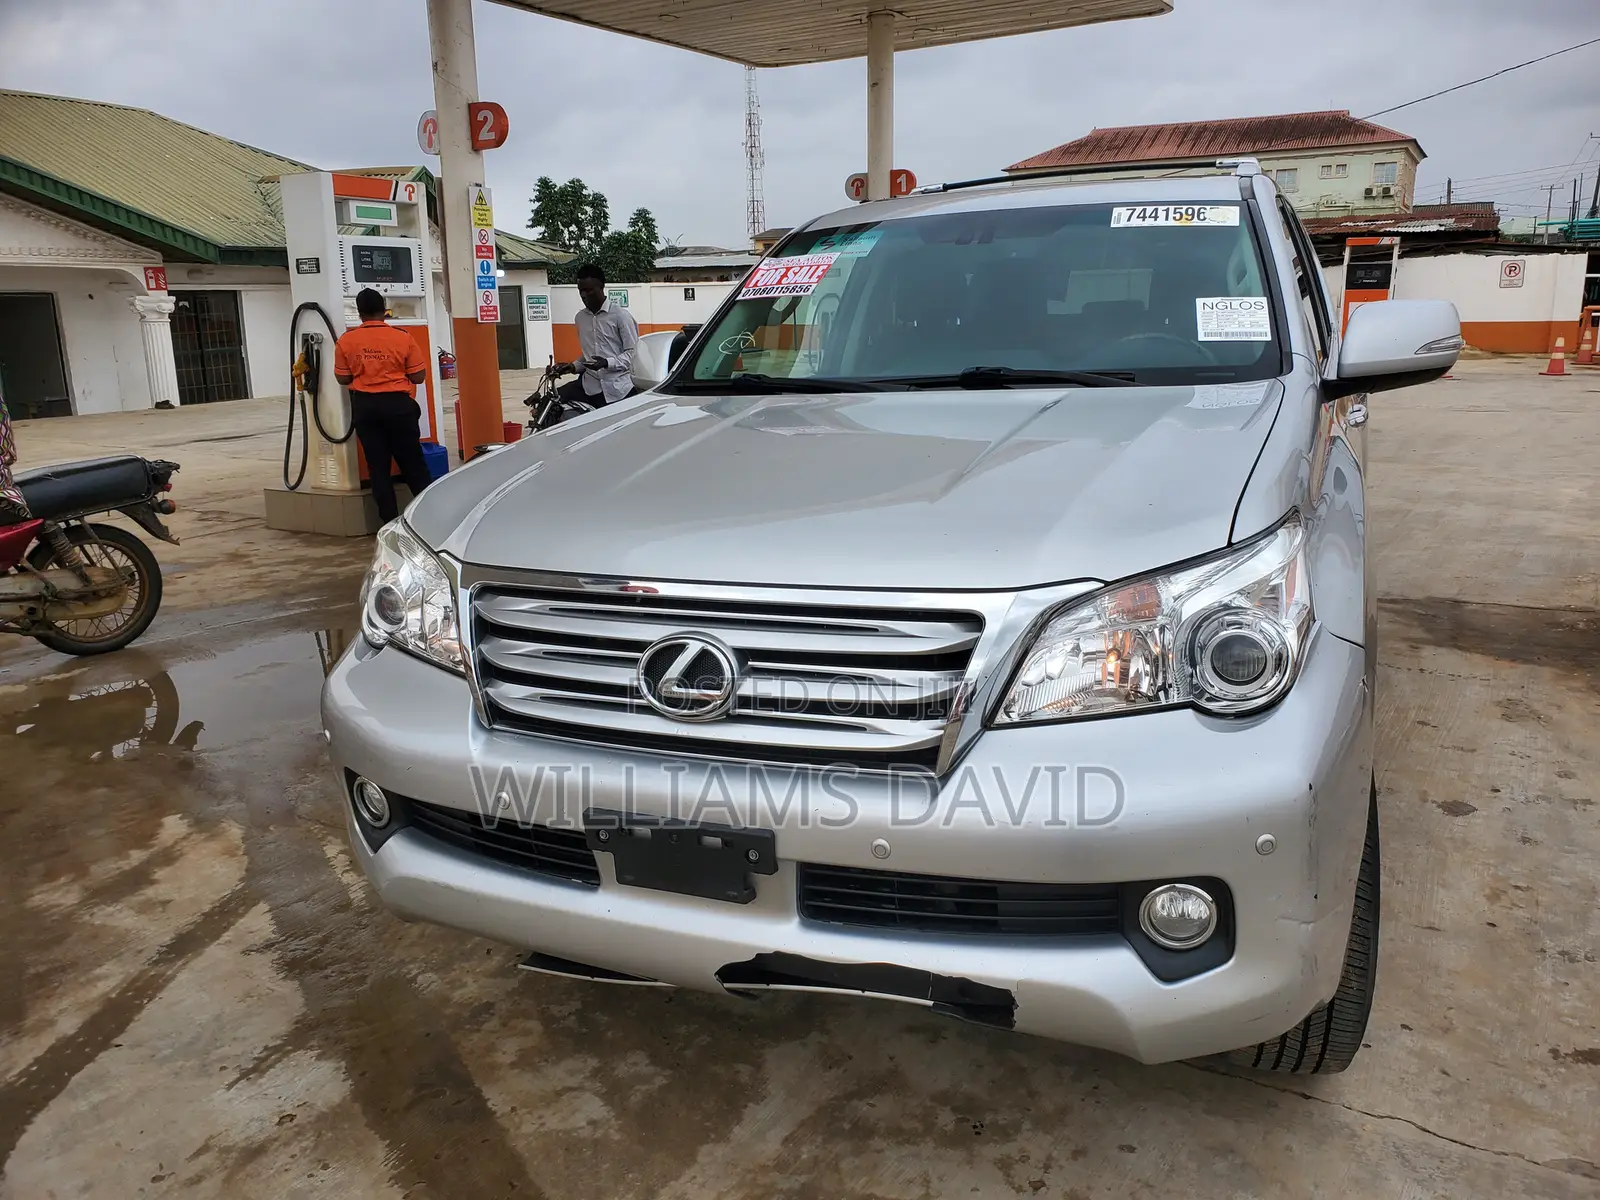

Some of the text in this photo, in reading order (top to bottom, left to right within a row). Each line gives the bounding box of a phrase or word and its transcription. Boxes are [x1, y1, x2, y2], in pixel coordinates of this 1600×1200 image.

[476, 109, 496, 141] 2
[896, 173, 907, 193] 1
[1125, 206, 1219, 222] 7441596
[749, 264, 828, 288] FOR SALE
[742, 285, 812, 298] 07080115856
[1202, 300, 1265, 310] NGLOS
